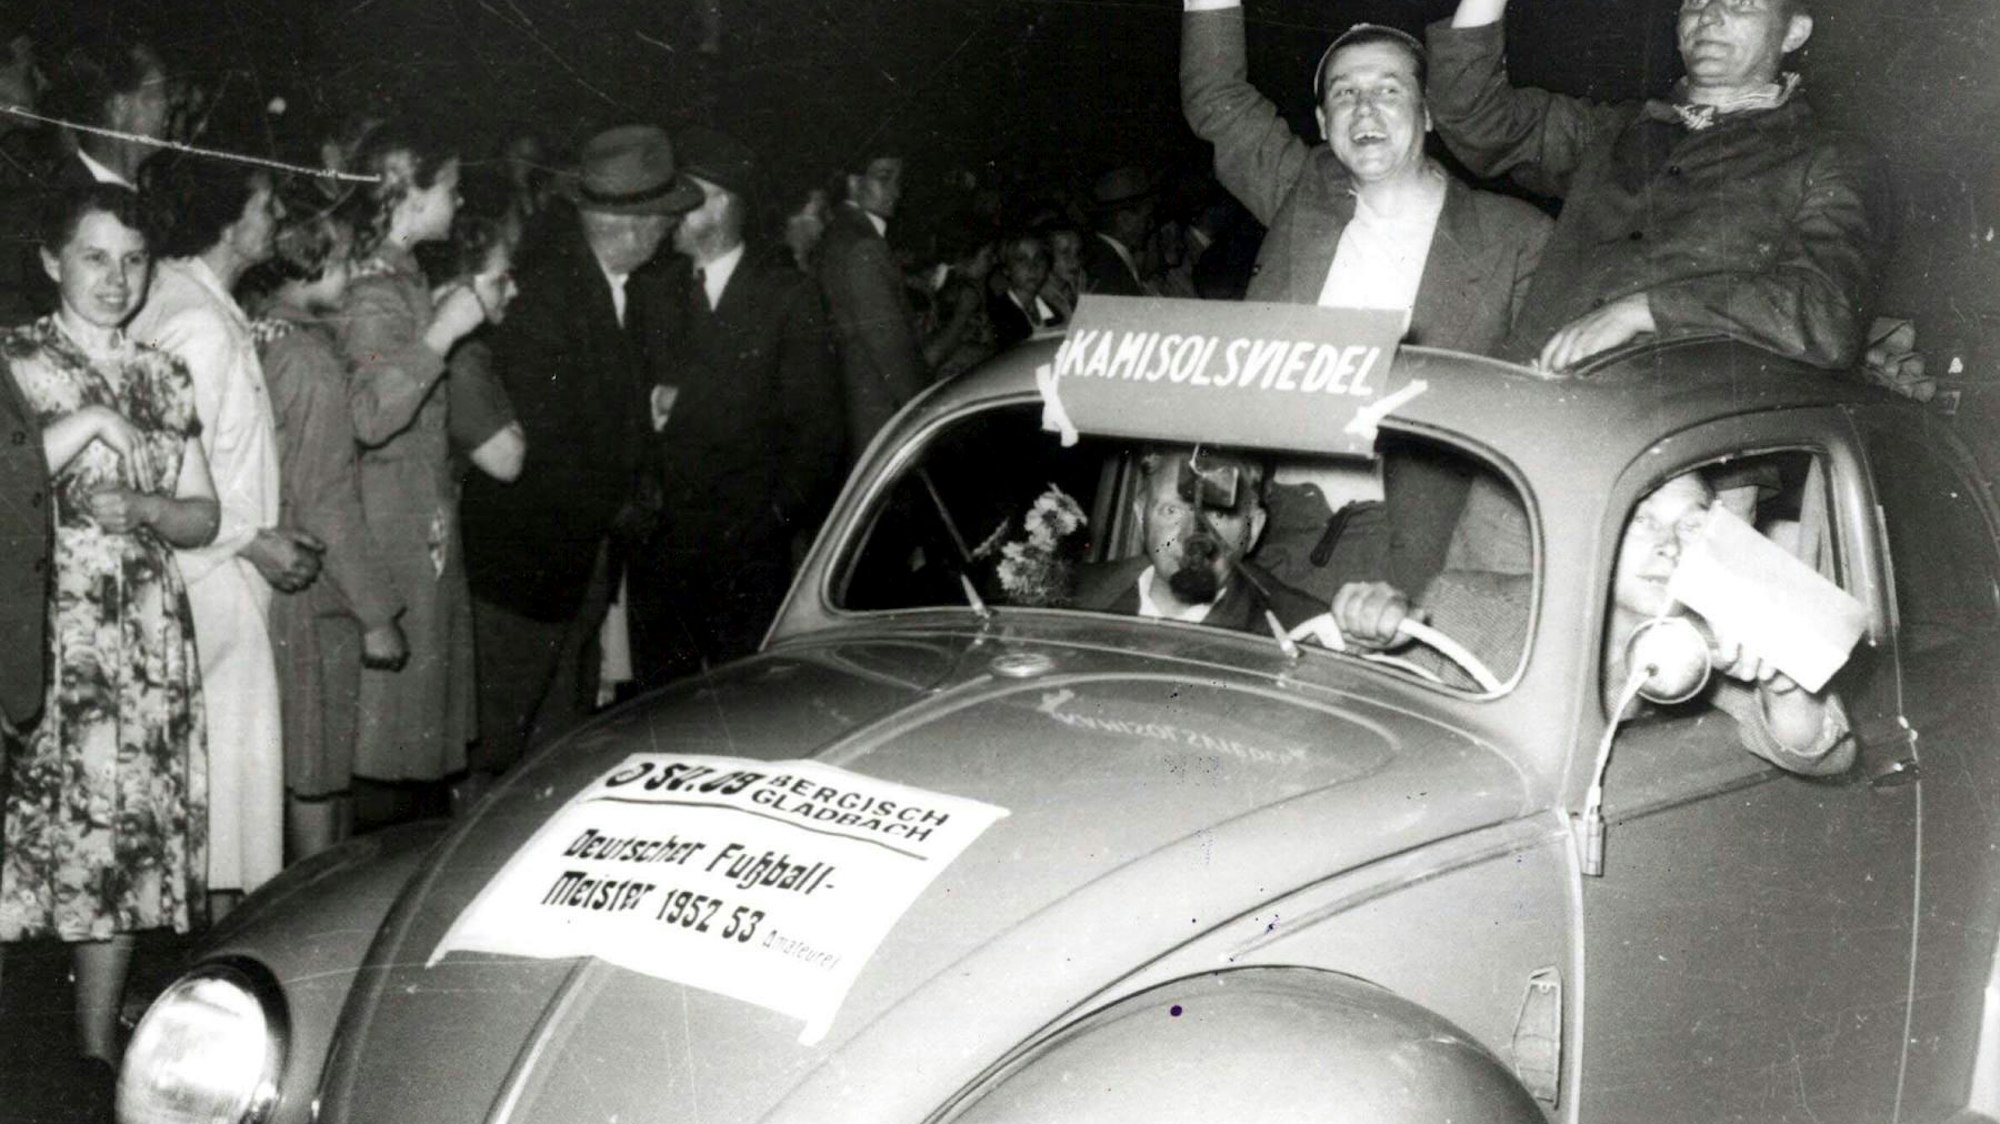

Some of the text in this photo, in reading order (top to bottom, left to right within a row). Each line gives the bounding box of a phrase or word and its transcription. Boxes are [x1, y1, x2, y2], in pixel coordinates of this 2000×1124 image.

[751, 788, 933, 843] GLADBACH
[768, 773, 950, 827] BERGISCH
[563, 829, 836, 895] Deutscher Fußball-
[540, 870, 657, 912] Meister
[655, 888, 724, 933] 1952
[721, 905, 766, 943] 53
